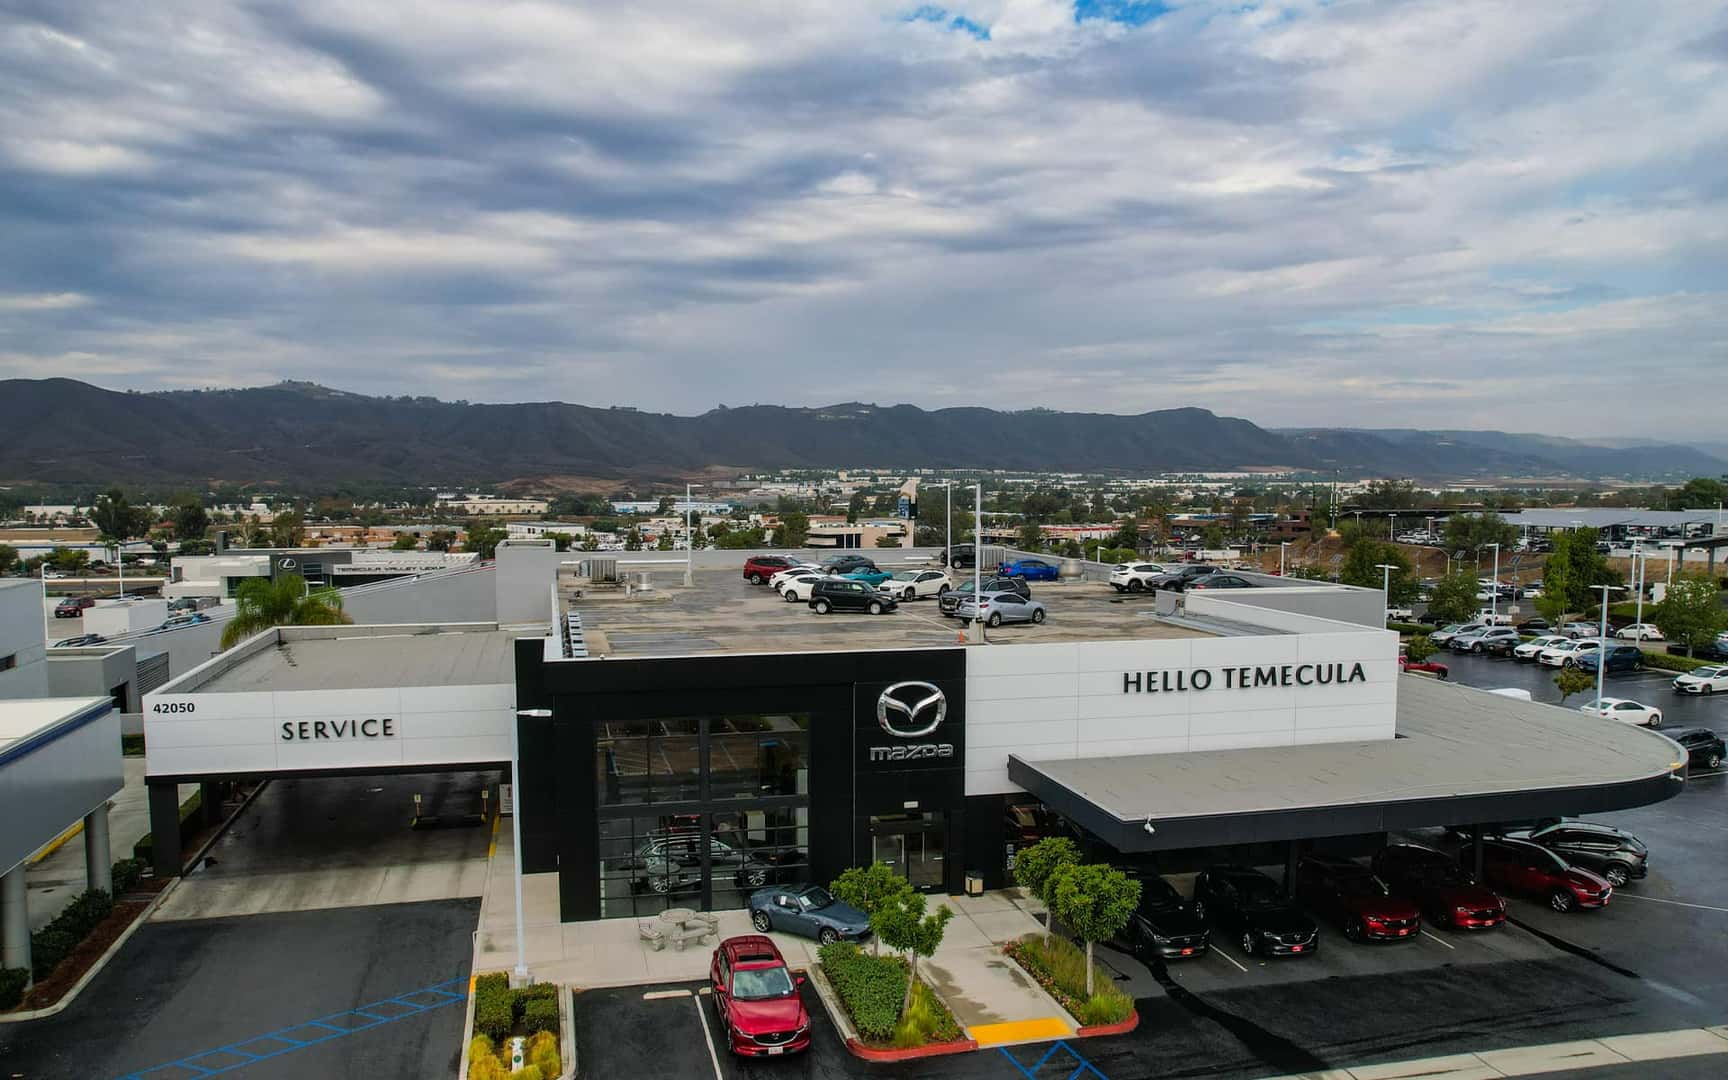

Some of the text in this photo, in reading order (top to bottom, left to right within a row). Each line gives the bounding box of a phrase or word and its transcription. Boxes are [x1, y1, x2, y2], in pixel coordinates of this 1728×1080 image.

[1123, 662, 1366, 693] HELLO TEMECULA
[153, 702, 195, 714] 42050
[281, 718, 394, 741] SERVICE
